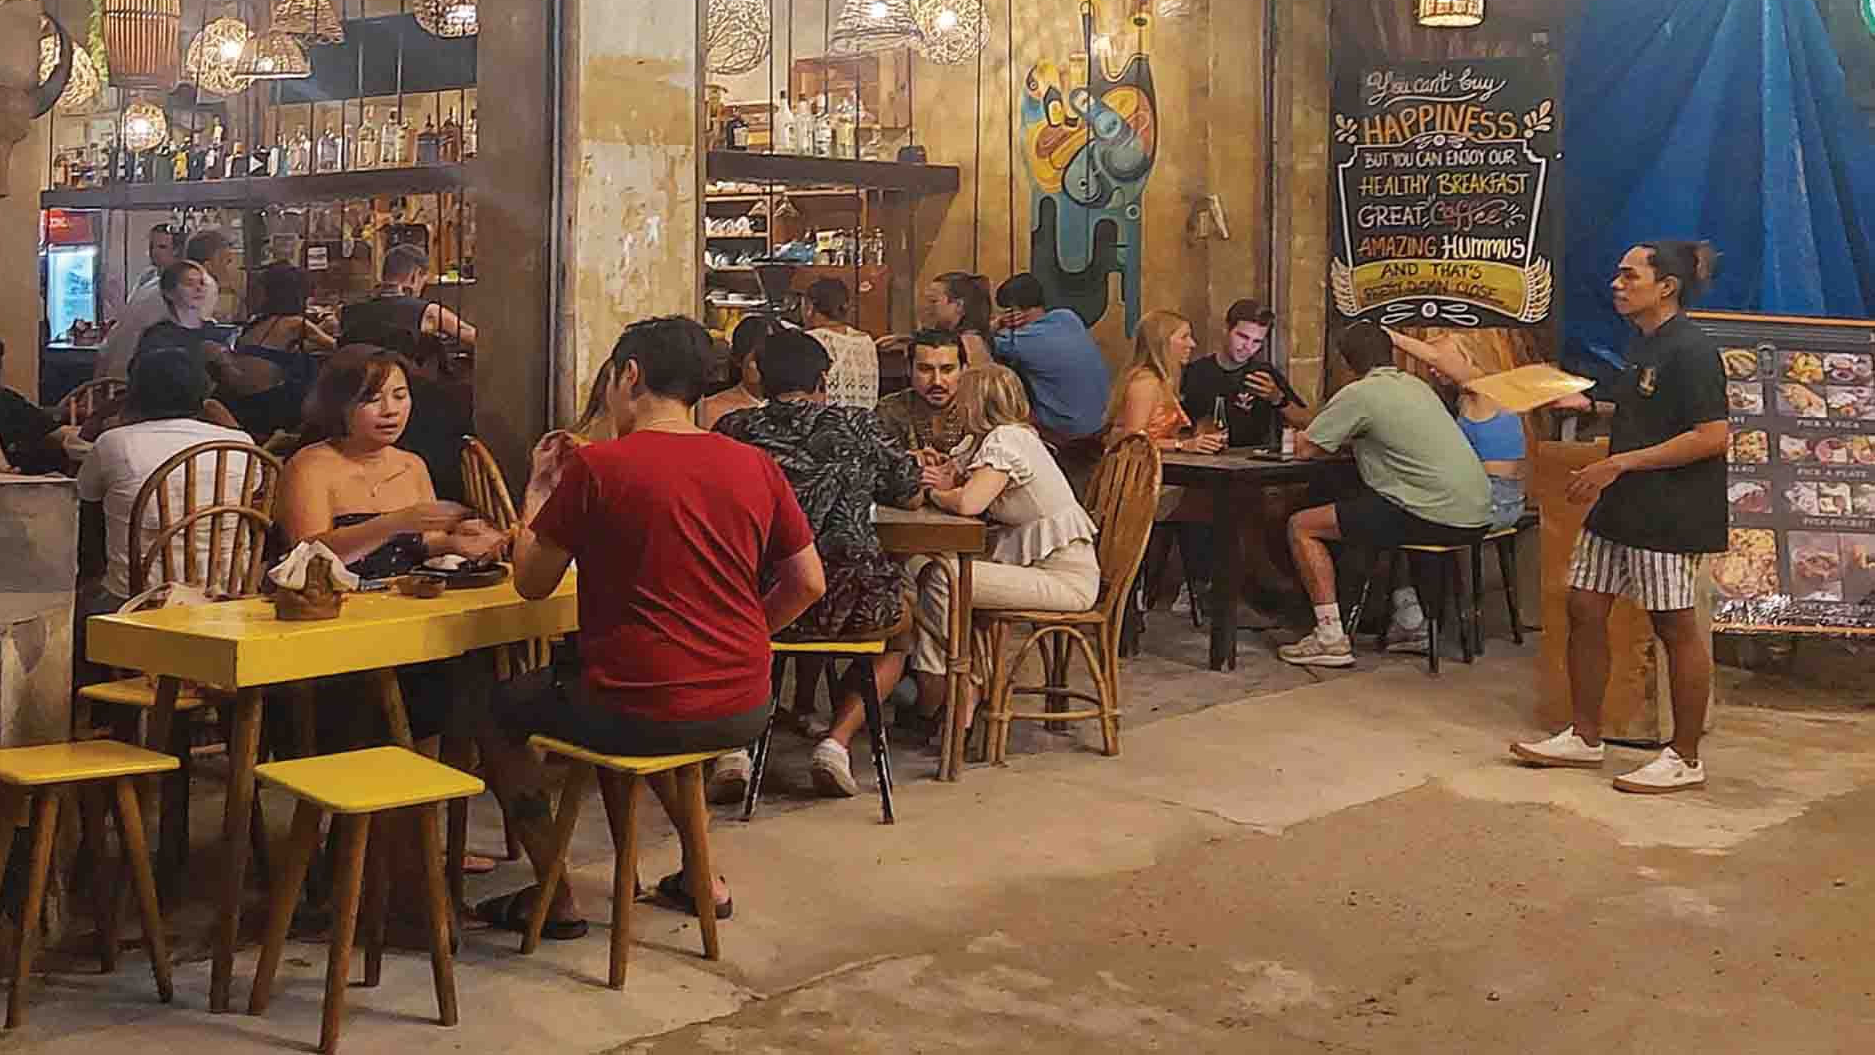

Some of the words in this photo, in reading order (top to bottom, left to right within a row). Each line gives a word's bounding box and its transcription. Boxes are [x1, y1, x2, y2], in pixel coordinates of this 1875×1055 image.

[1367, 70, 1411, 106] You
[1459, 66, 1507, 102] buy
[1364, 103, 1518, 146] HAPPINESS
[1364, 152, 1390, 169] BUT
[1392, 151, 1415, 167] YOU
[1416, 150, 1443, 168] CAN
[1446, 149, 1486, 166] ENJOY
[1488, 148, 1518, 166] OUR
[1358, 173, 1431, 197] HEALTHY
[1436, 171, 1529, 195] BREAKFAST
[1357, 203, 1425, 229] GREAT
[1429, 198, 1508, 232] Coffee
[1357, 235, 1437, 258] AMAZING
[1381, 262, 1419, 280] AND
[1430, 262, 1483, 280] THAT'S
